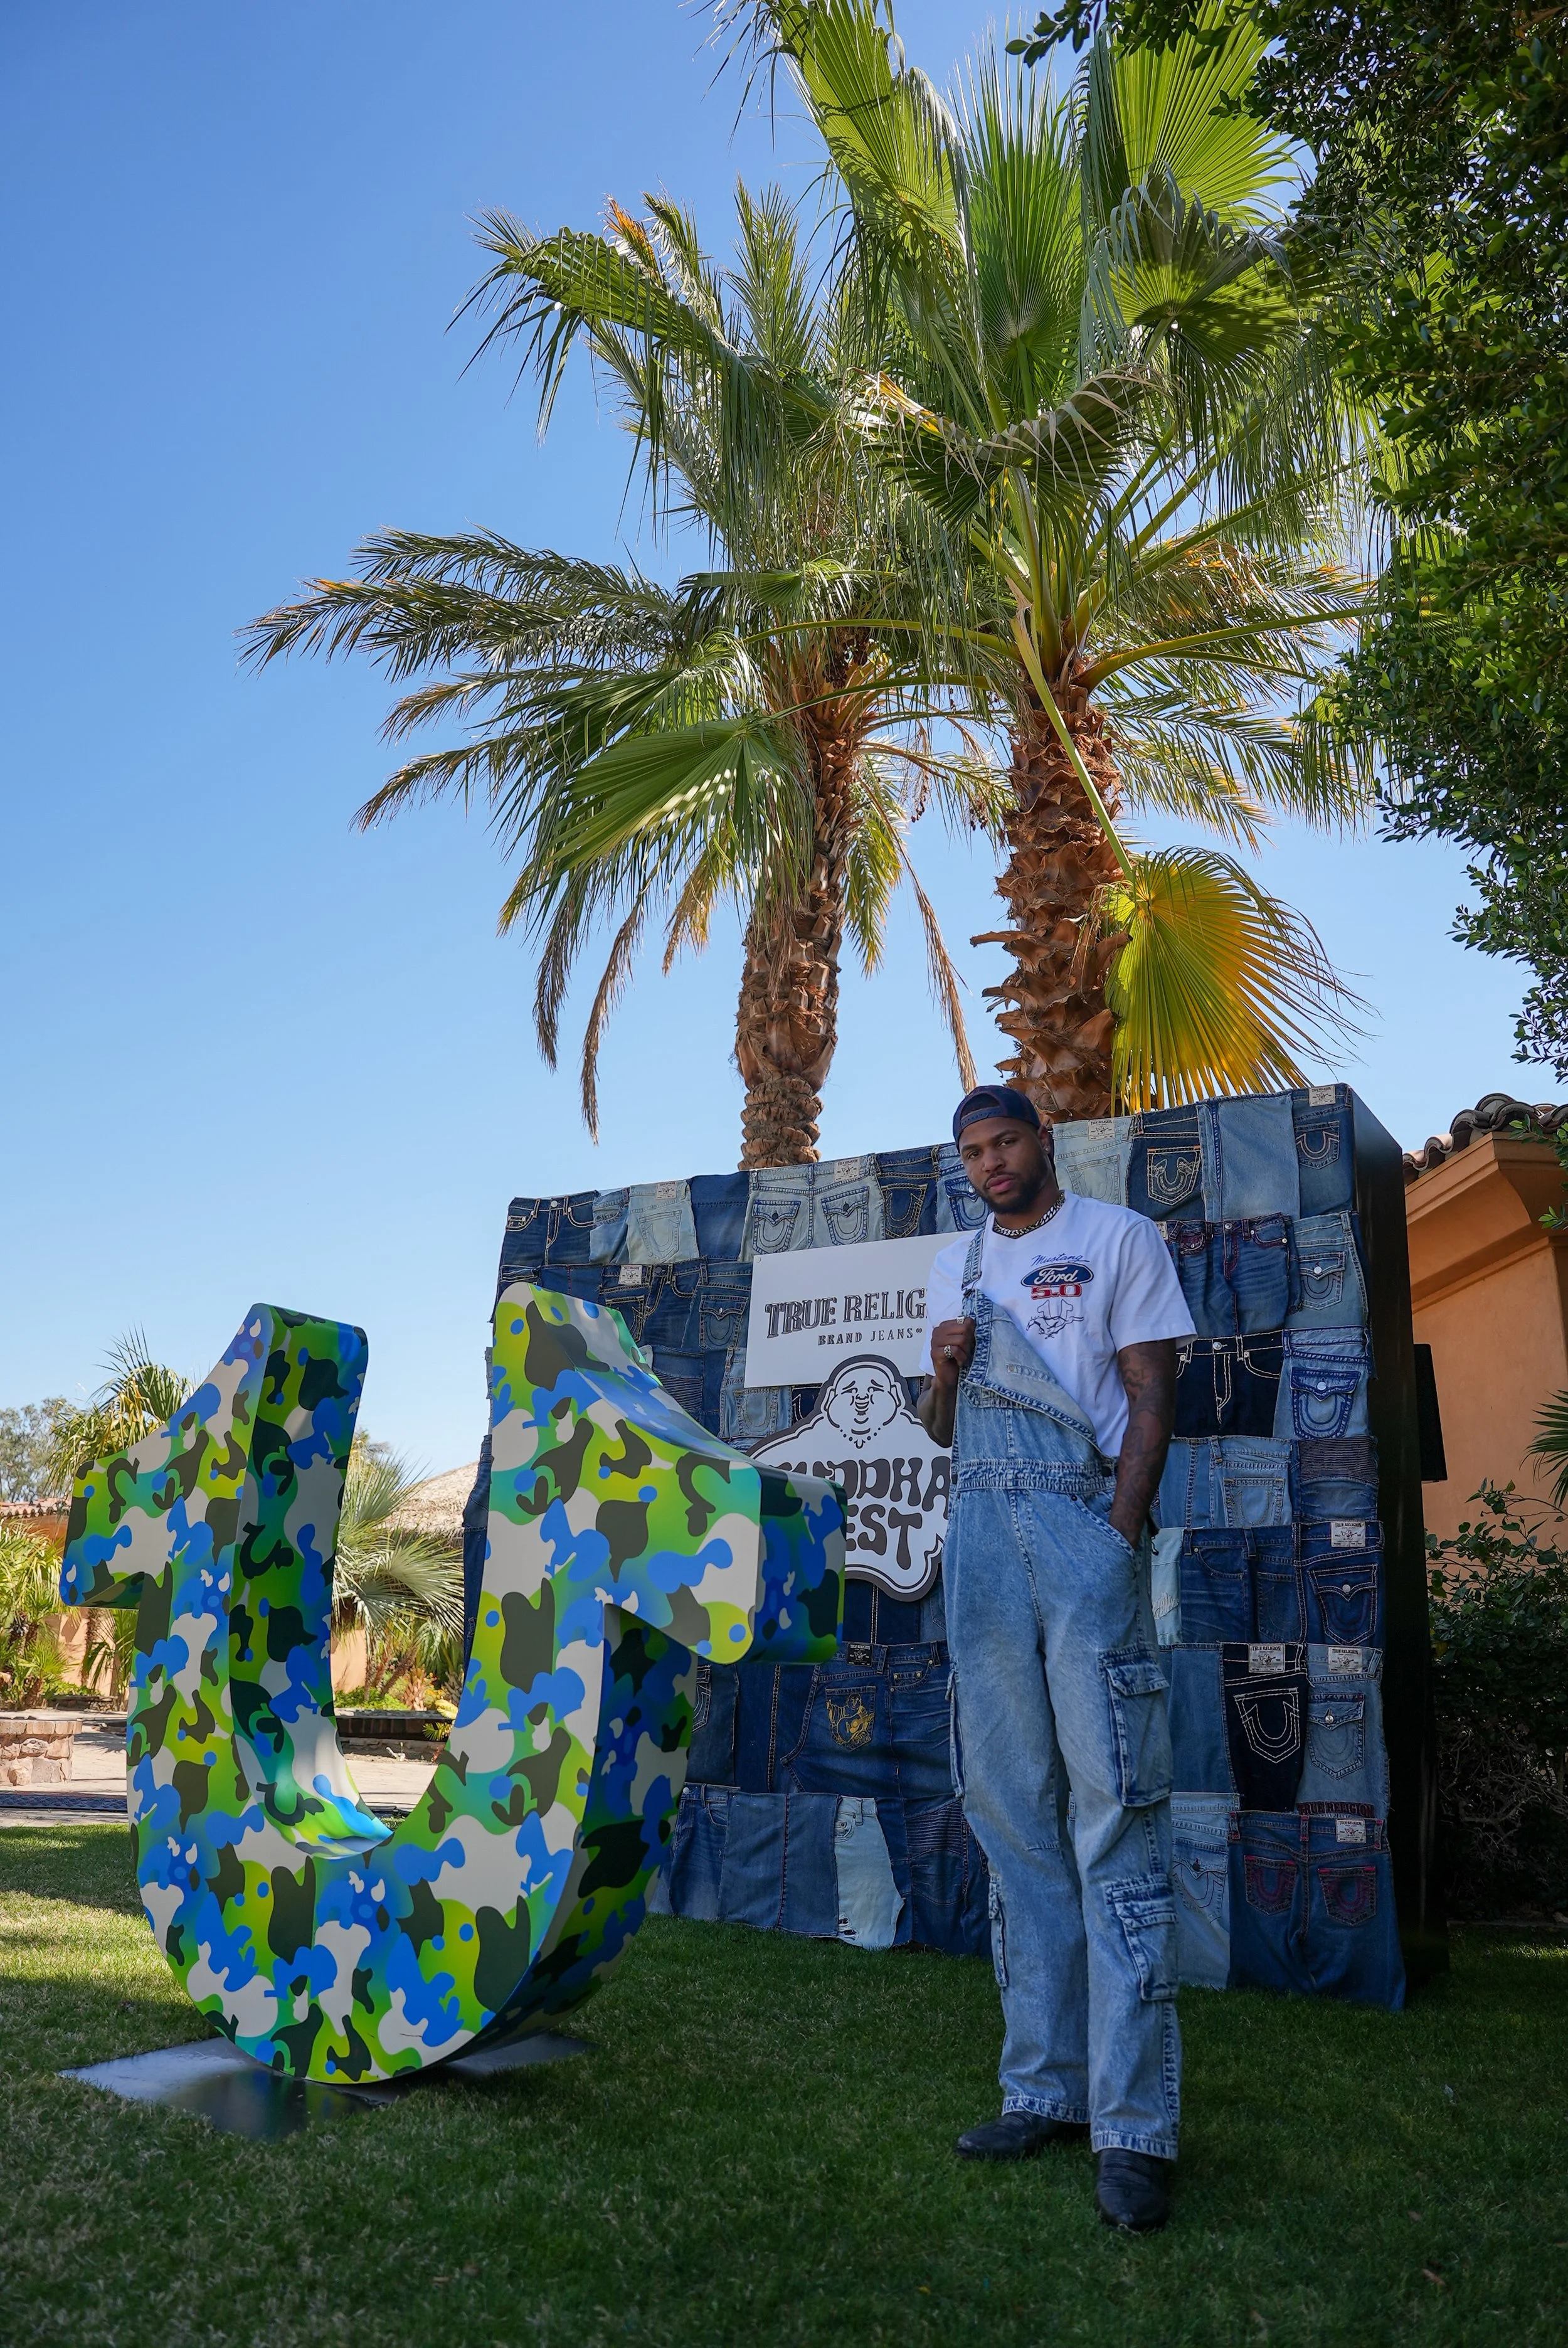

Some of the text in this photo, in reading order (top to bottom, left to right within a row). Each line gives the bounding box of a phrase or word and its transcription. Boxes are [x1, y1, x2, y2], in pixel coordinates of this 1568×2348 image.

[1030, 1253, 1090, 1266] Mustang
[1034, 1266, 1078, 1285] Ford
[1031, 1283, 1082, 1300] 5.0
[765, 1287, 928, 1339] TRUE RELIG
[818, 1332, 862, 1346] BRAND
[768, 1456, 951, 1520] DDHA
[1296, 1801, 1375, 1818] TRUE RELIGION
